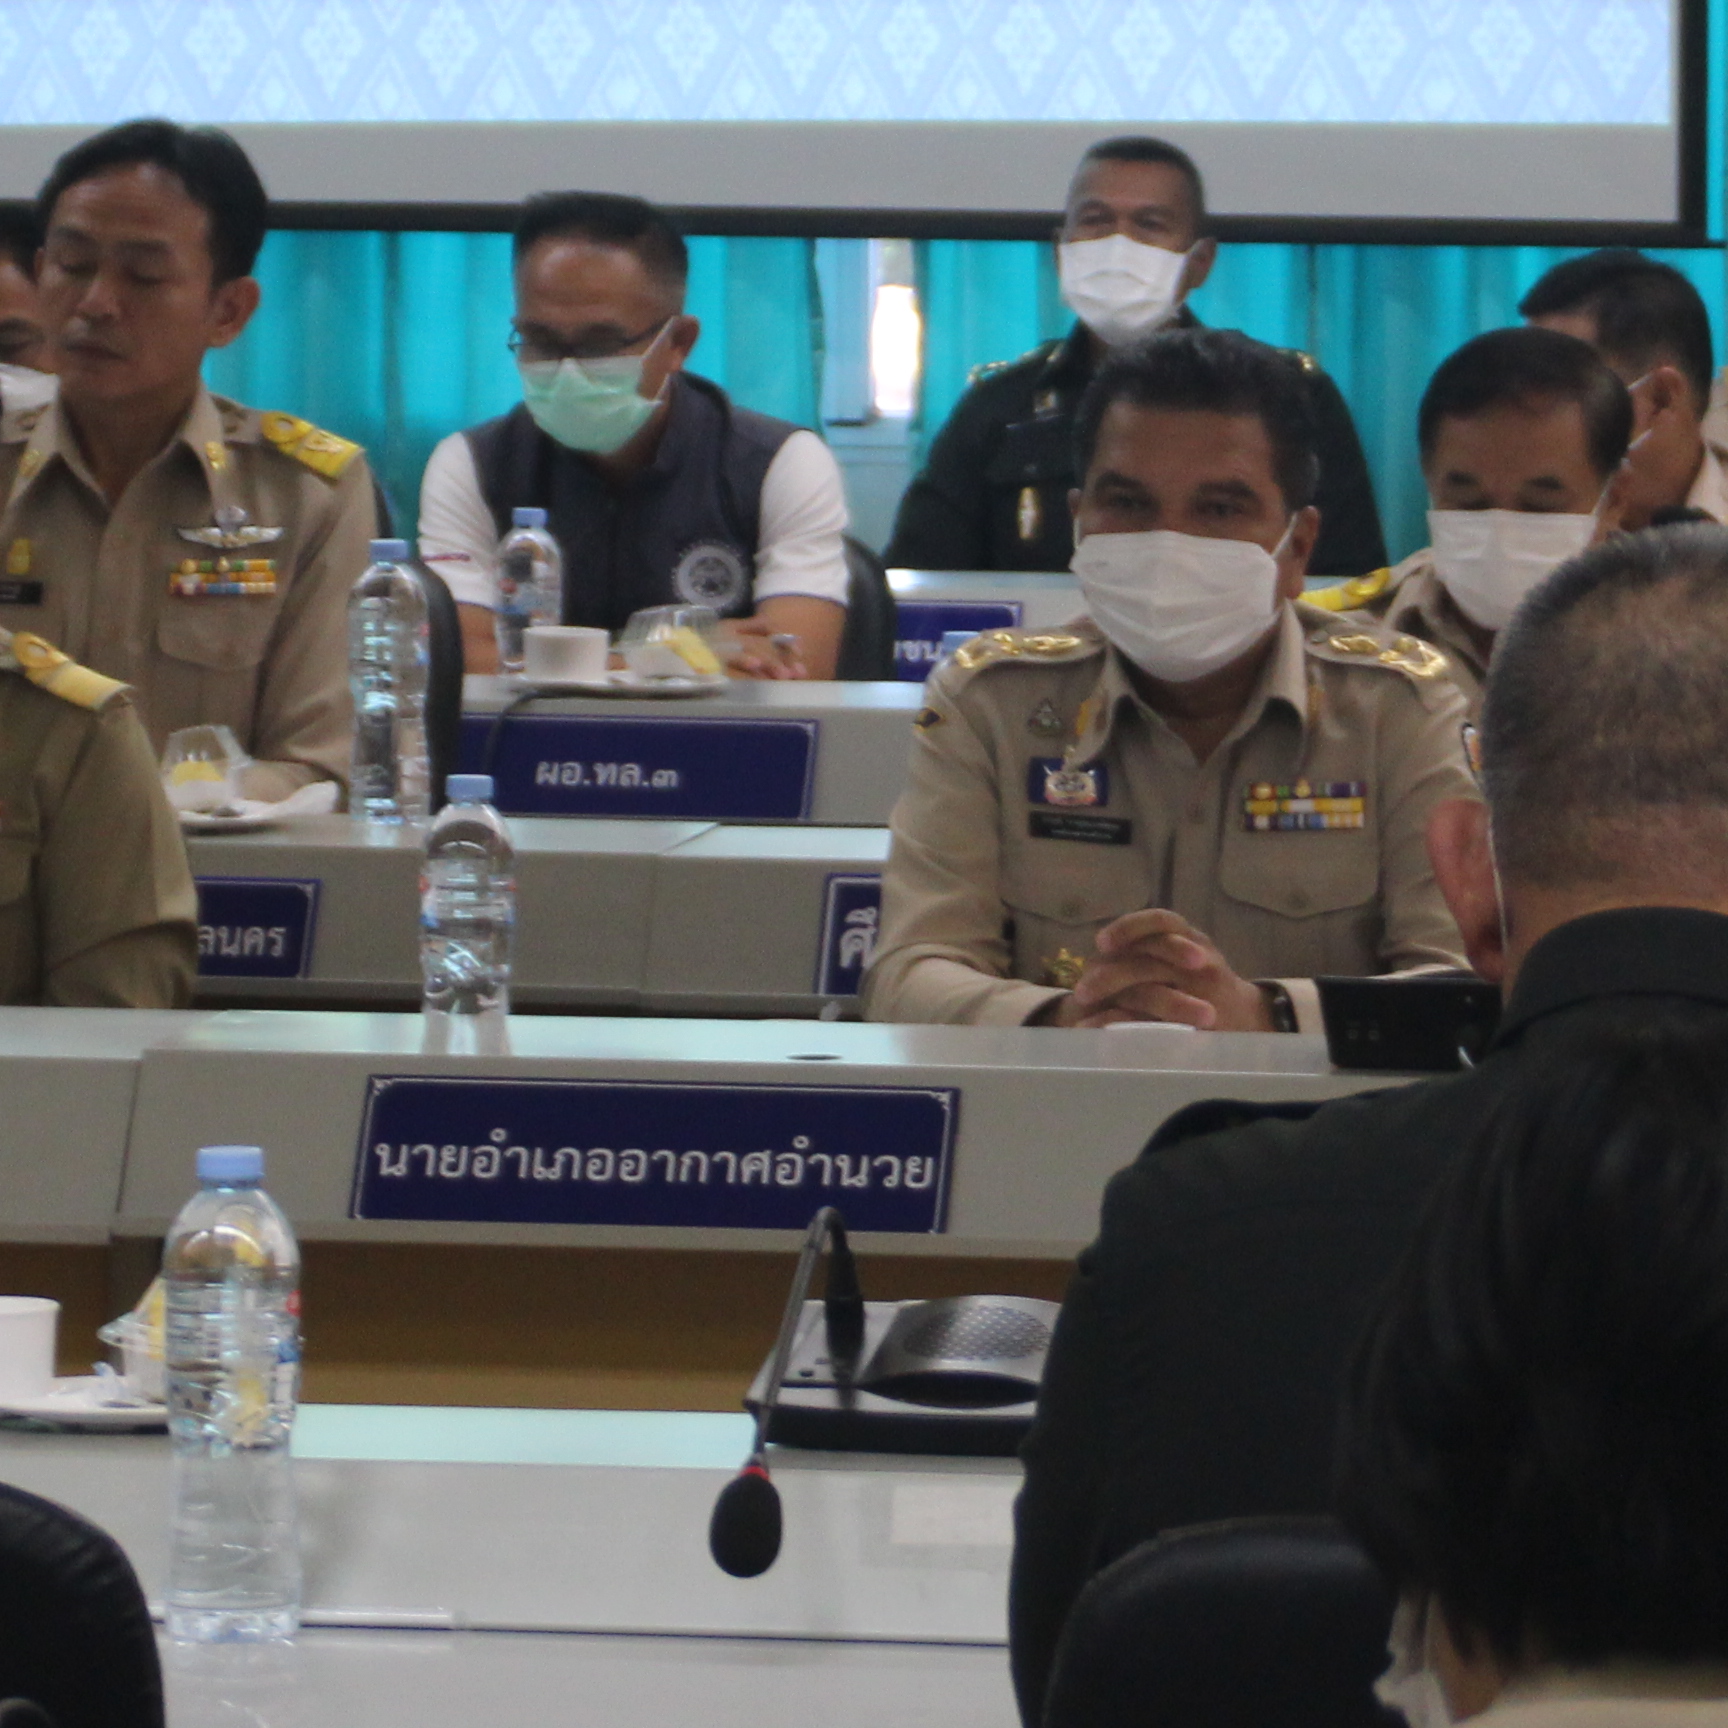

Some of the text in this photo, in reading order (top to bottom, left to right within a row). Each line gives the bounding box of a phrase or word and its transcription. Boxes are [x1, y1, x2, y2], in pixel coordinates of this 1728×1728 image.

[375, 1127, 935, 1189] นายอำเภออากาศอำนวย
